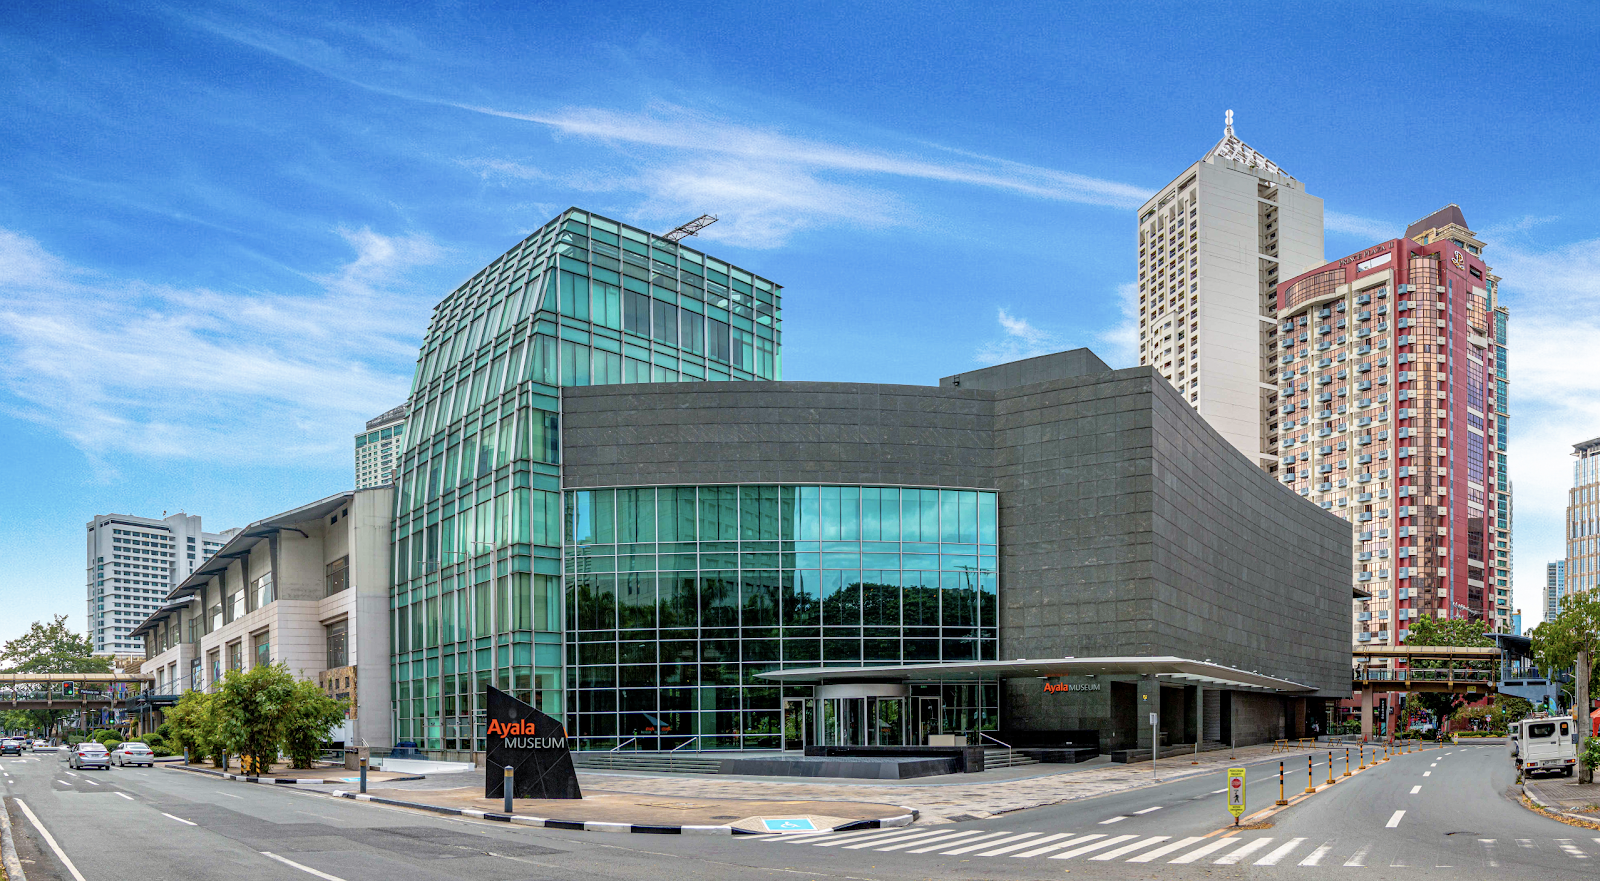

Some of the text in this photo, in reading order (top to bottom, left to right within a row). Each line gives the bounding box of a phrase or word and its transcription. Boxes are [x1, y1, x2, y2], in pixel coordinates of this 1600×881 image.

[1339, 253, 1362, 267] PRINCE
[1363, 245, 1386, 258] PLAZA
[1043, 682, 1069, 694] Ayala
[487, 719, 535, 738] Ayala
[504, 737, 565, 749] MUSEUM
